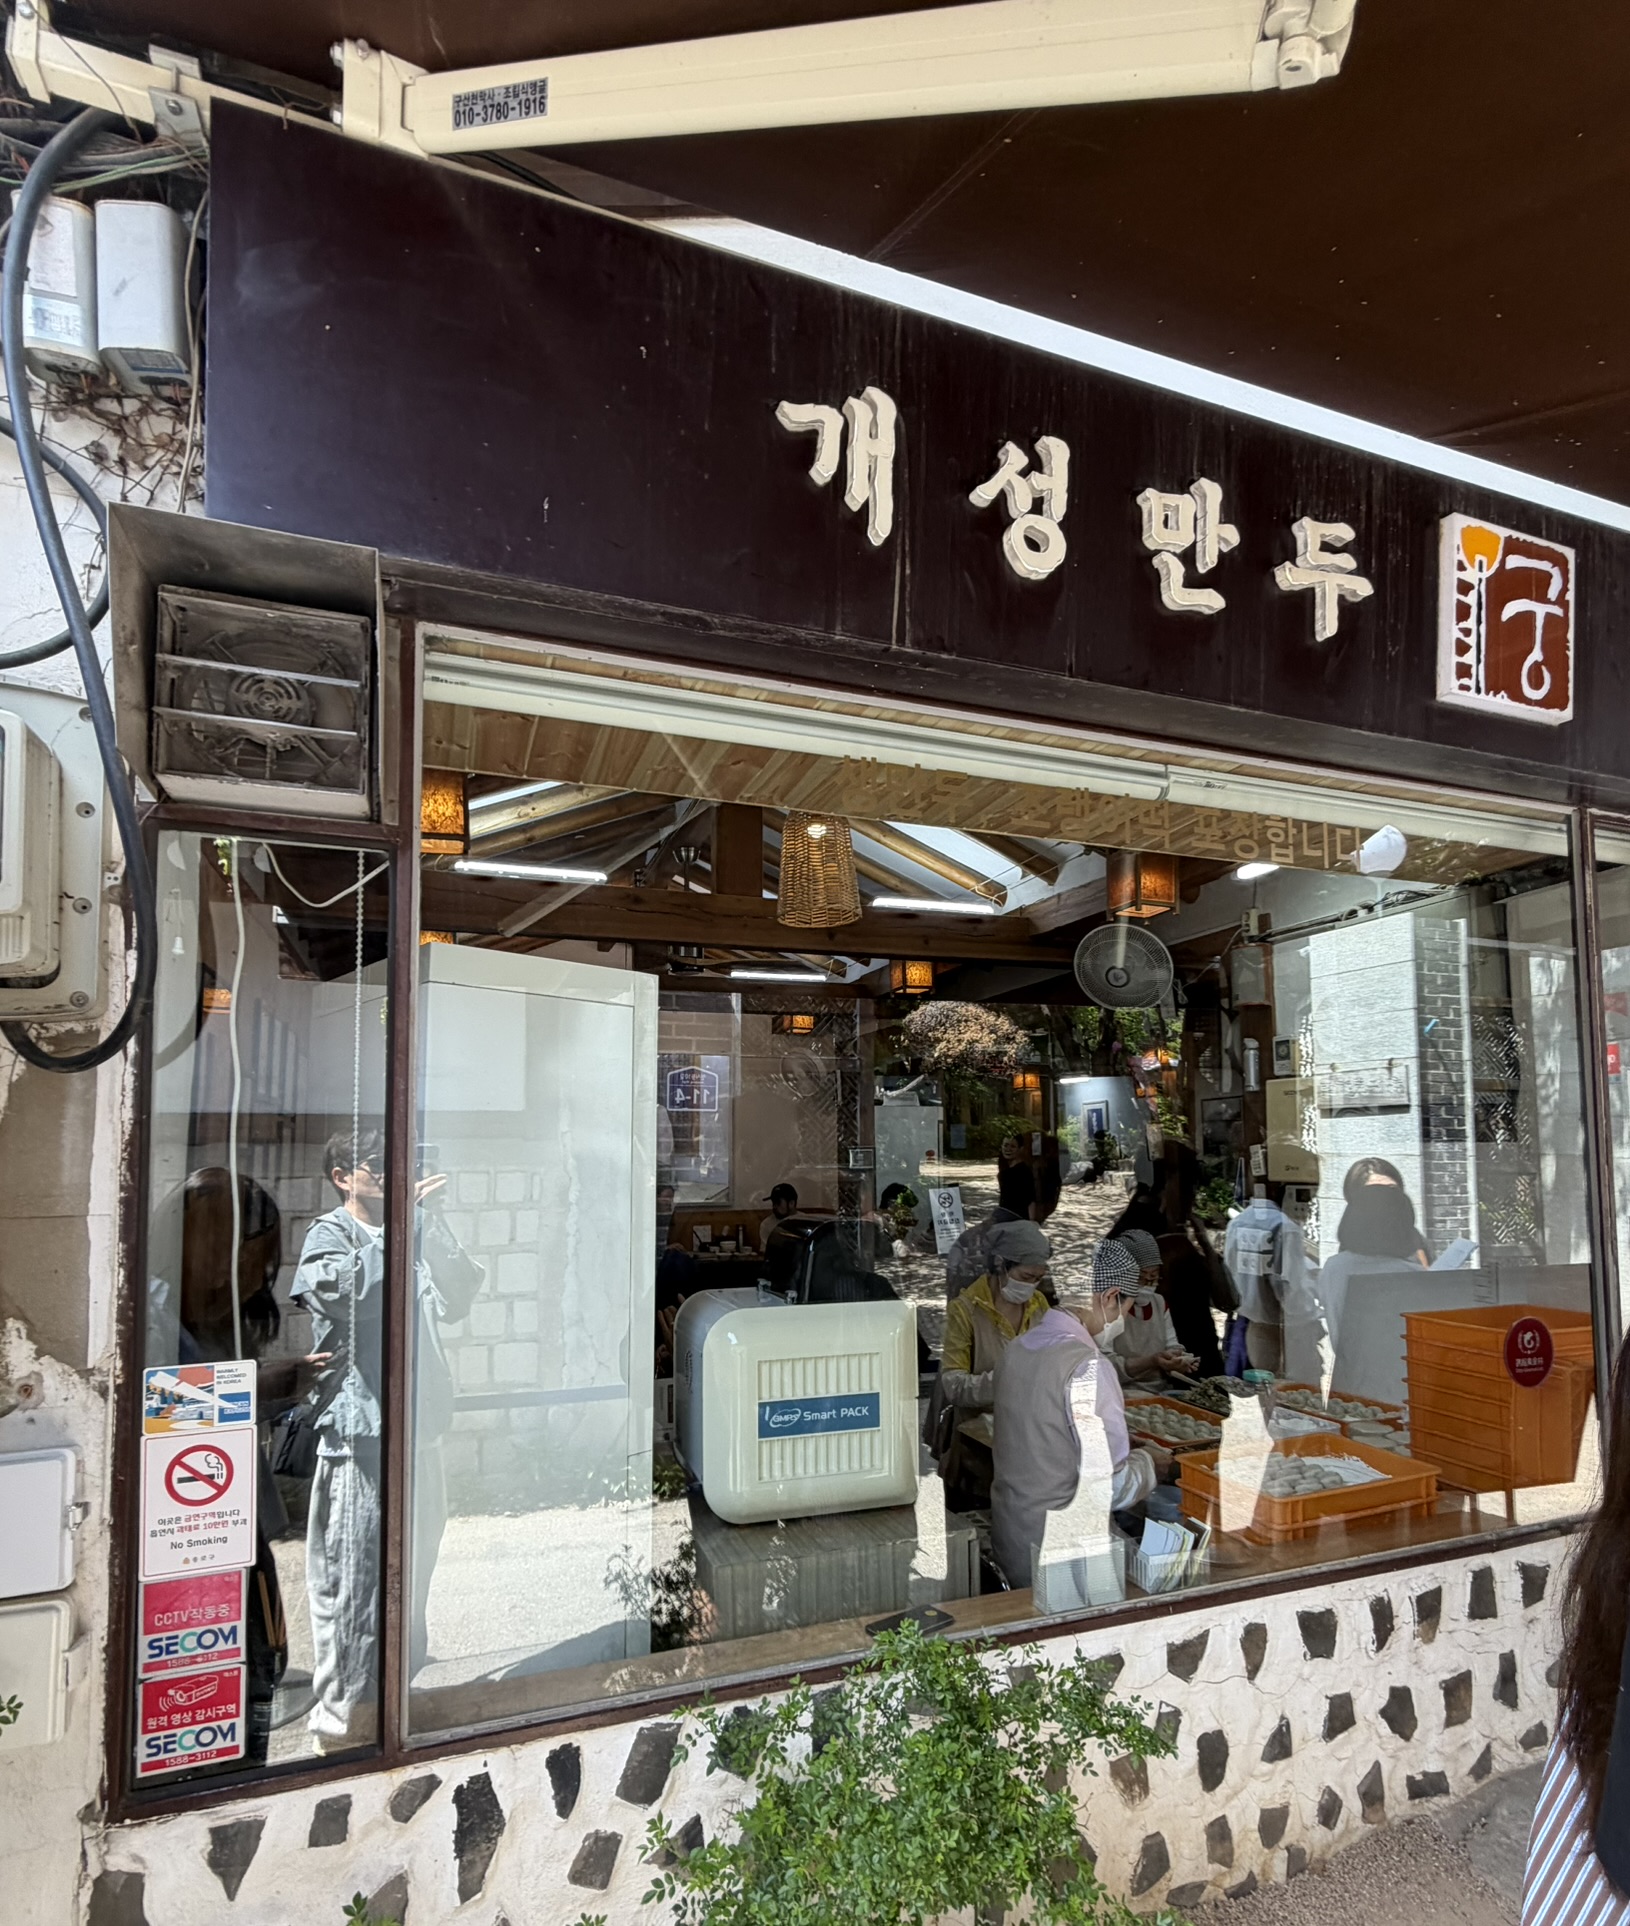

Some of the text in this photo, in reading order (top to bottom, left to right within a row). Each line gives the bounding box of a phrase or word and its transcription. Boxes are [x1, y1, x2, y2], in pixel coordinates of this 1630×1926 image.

[454, 94, 546, 127] 010-3780-1916
[776, 386, 1374, 642] 개성만두
[1191, 807, 1361, 873] 포장합니다
[803, 1409, 837, 1421] Smart
[840, 1406, 869, 1418] PACK
[150, 1518, 248, 1537] 흡연시 과태료 10만원 부과
[157, 1509, 240, 1526] 이곳은 금연구역입니다
[170, 1535, 228, 1550] No Smoking
[154, 1602, 231, 1626] CCTV작동중
[147, 1625, 238, 1659] SECOM
[147, 1703, 236, 1729] 원격 영상 감시구역
[145, 1722, 236, 1758] SECOM
[165, 1750, 217, 1766] 1588-3112
